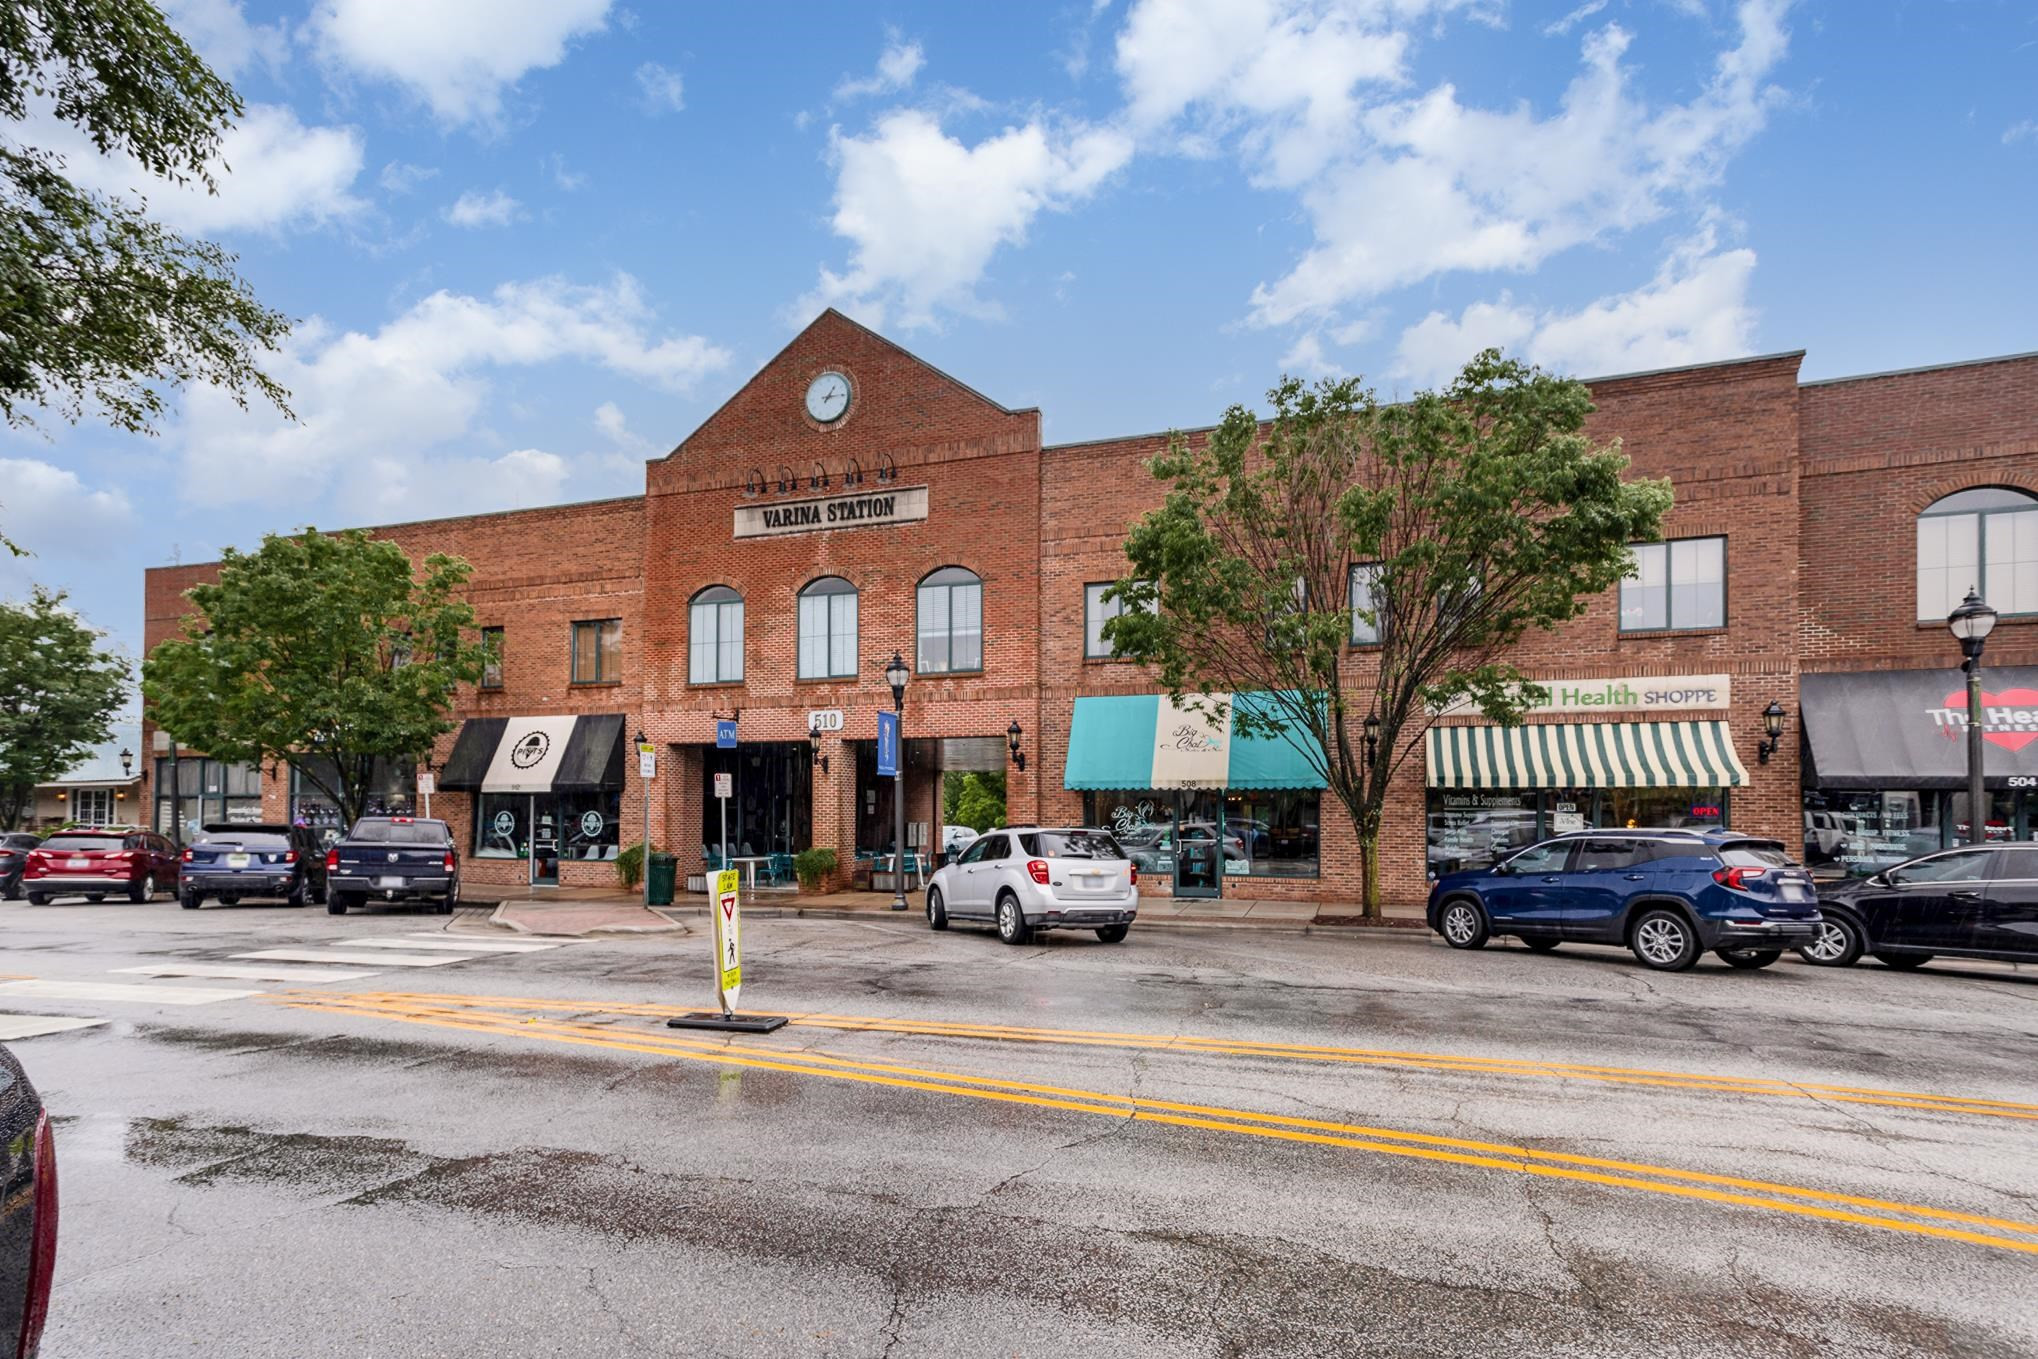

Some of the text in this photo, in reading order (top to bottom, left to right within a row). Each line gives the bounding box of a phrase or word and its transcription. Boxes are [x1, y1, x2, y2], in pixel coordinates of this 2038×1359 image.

[763, 496, 896, 529] VARINA STATION
[1562, 684, 1638, 706] Health
[1644, 689, 1718, 705] SHOPPE
[814, 713, 837, 729] 510
[719, 729, 736, 740] ATM
[1173, 725, 1198, 738] Big
[1181, 780, 1197, 788] 508
[2008, 776, 2037, 787] 504
[1442, 794, 1521, 807] Vitamins & Supplements
[1558, 803, 1575, 811] OPEN
[1692, 807, 1719, 817] OPEN
